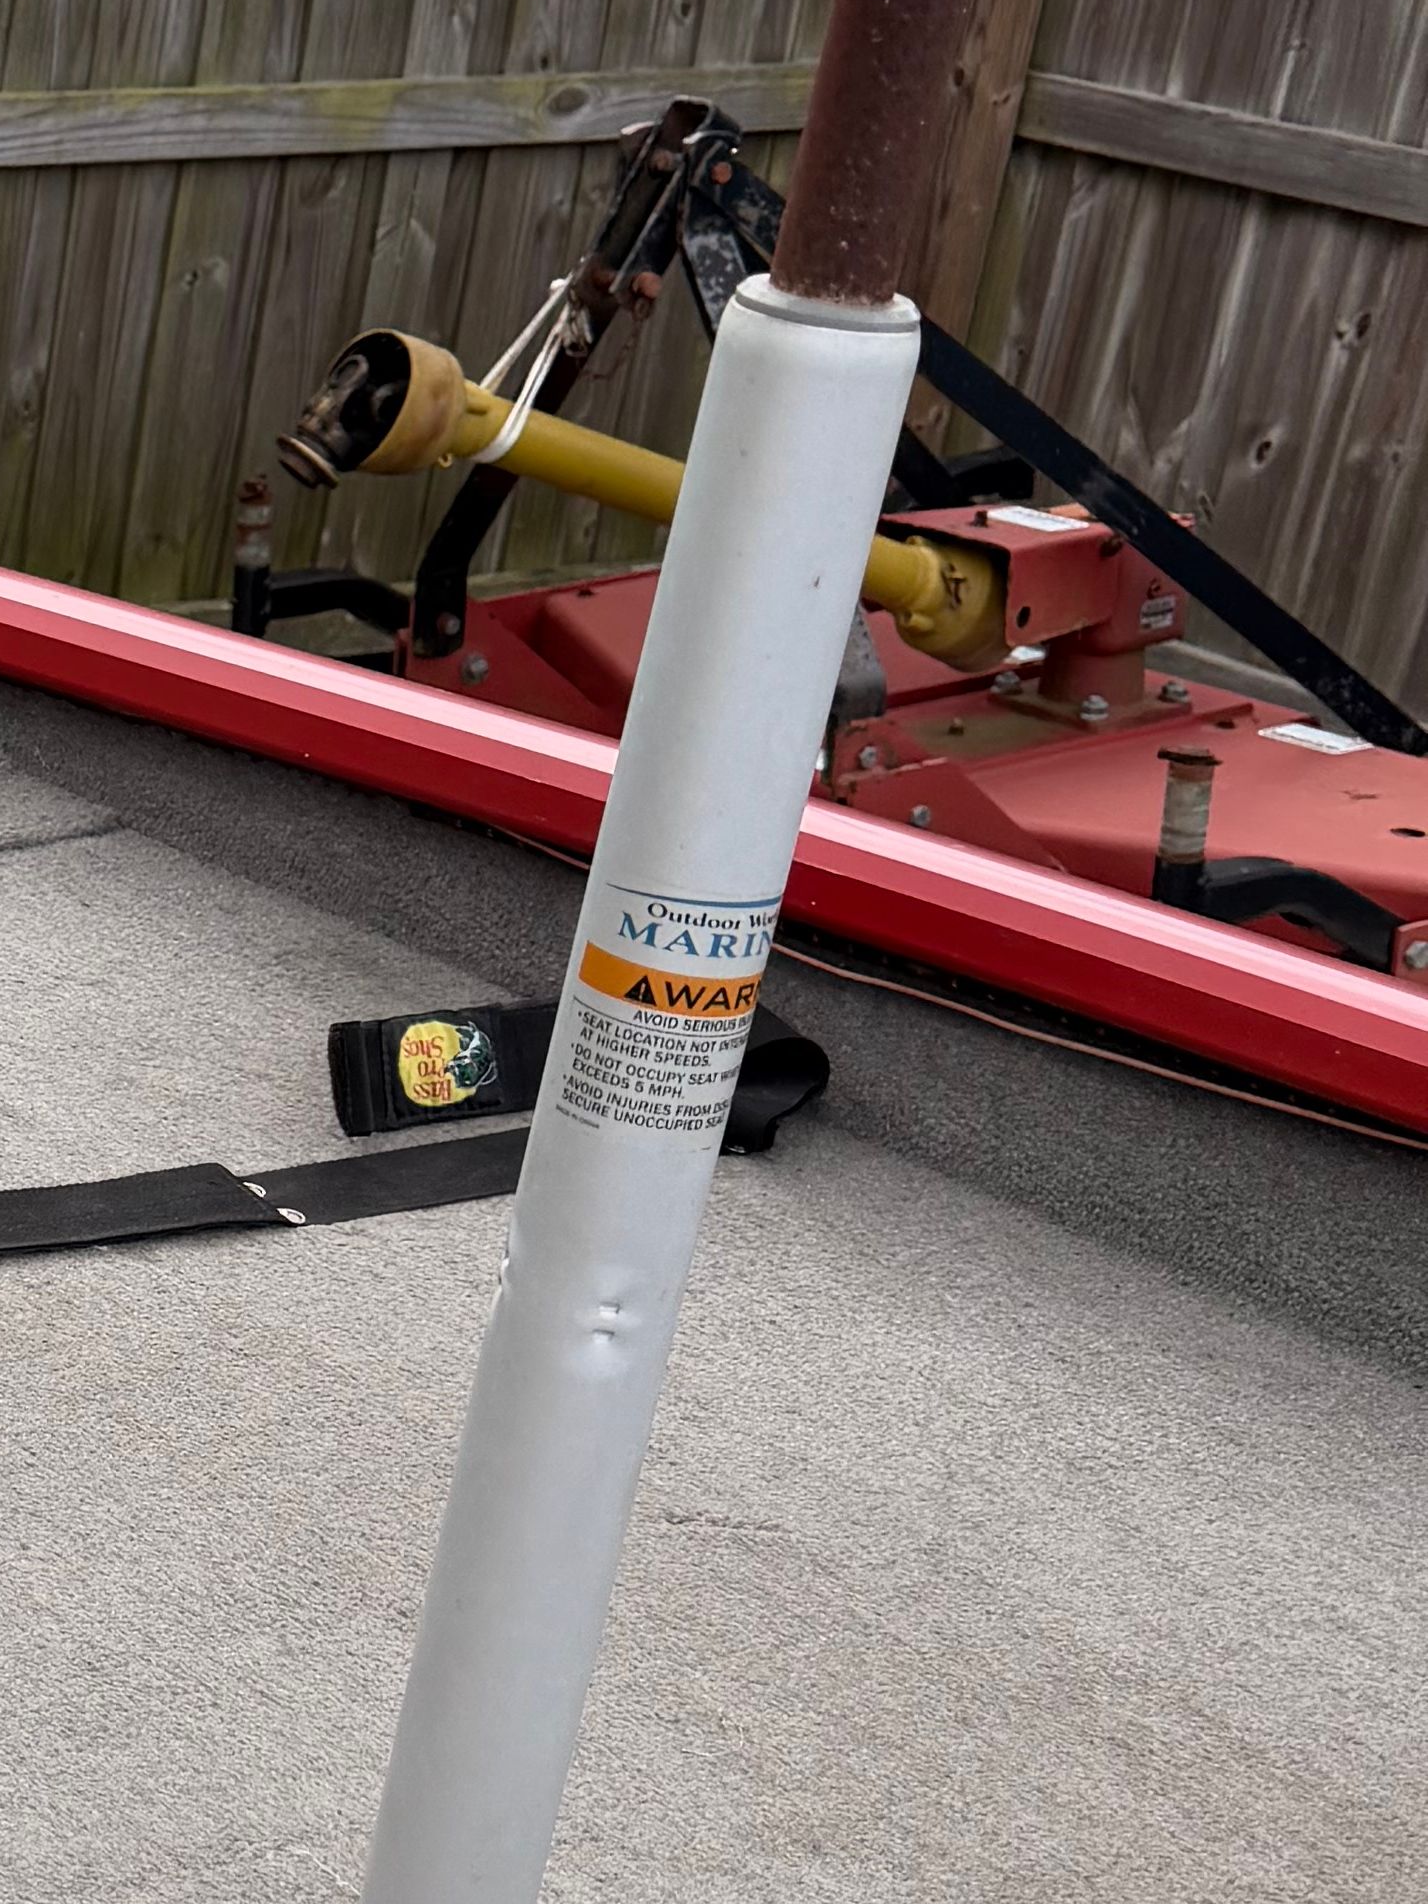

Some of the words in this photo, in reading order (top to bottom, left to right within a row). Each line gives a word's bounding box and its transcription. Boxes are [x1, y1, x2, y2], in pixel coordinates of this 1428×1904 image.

[647, 902, 741, 930] Outdoor
[582, 1011, 613, 1034] SEAT
[614, 1025, 687, 1052] LOCATION
[690, 1040, 718, 1053] NOT
[633, 1010, 679, 1029] AVOID
[682, 1019, 737, 1033] SERIOUS
[580, 1026, 594, 1041] AT
[596, 1034, 651, 1061] HIGHER
[572, 1058, 630, 1089] EXCEEDS
[574, 1043, 592, 1061] DO
[594, 1052, 623, 1072] NOT
[625, 1064, 685, 1084] OCCUPY
[561, 1087, 611, 1118] SECURE
[614, 1108, 704, 1131] UNOCCUPIED
[566, 1075, 604, 1100] AVOID
[605, 1092, 672, 1116] INJURIES
